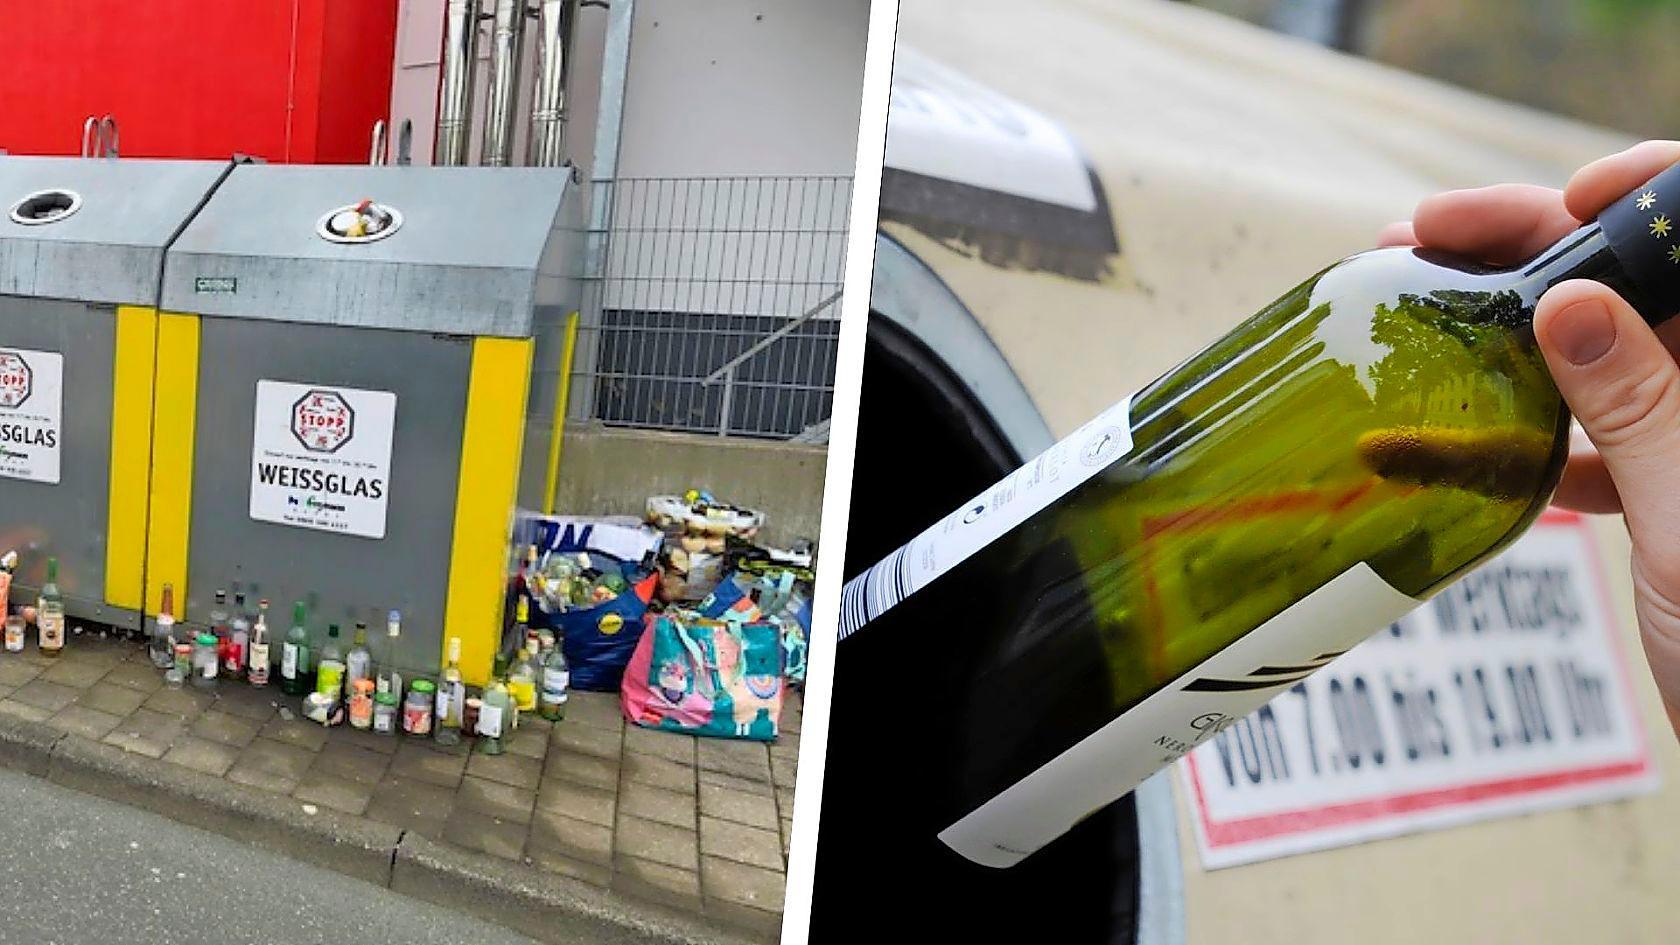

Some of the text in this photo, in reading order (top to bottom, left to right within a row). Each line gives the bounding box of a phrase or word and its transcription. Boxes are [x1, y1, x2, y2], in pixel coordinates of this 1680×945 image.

[300, 414, 345, 427] STOPP
[0, 424, 57, 449] SGLAS
[258, 462, 383, 499] WEISSGLAS
[1383, 667, 1451, 762] bis
[1555, 658, 1614, 740] Uhr
